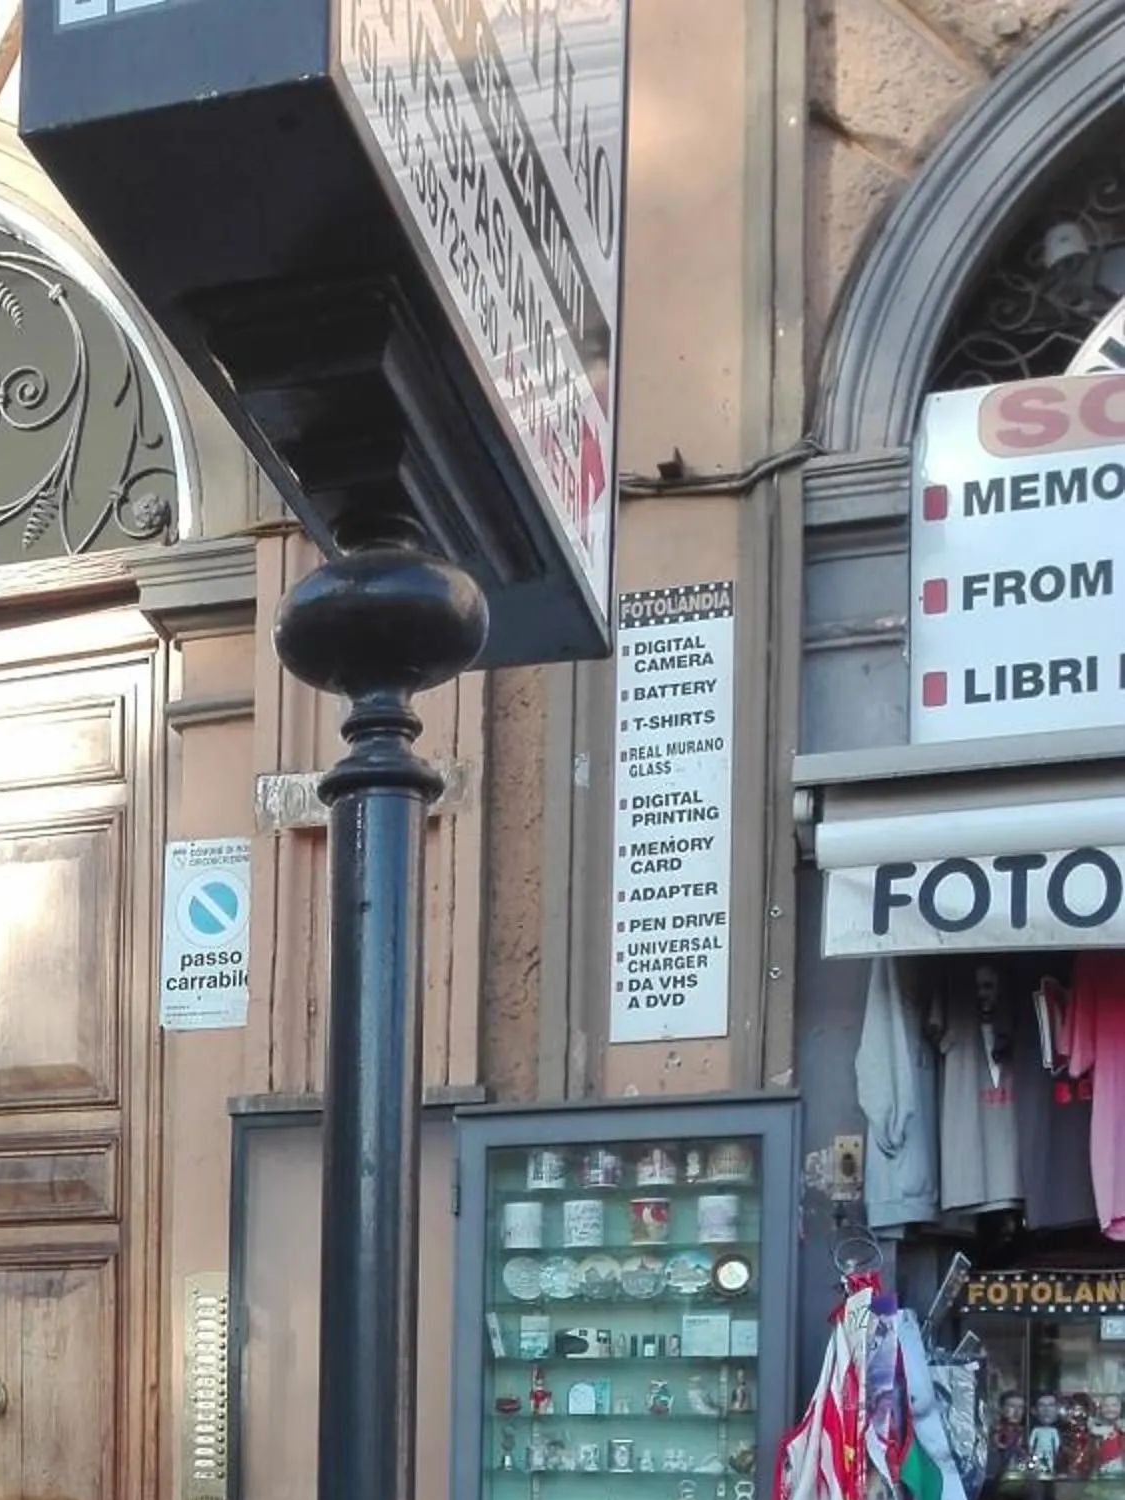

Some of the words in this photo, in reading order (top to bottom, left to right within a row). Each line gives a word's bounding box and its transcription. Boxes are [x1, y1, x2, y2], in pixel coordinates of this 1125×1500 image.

[552, 15, 614, 260] HAO
[475, 20, 536, 228] SENZA
[540, 184, 584, 342] LIMITI
[962, 558, 1114, 611] FROM
[621, 590, 731, 620] FOTOLANDIA
[634, 635, 706, 656] DIGITAL
[634, 652, 714, 673] CAMERA
[634, 678, 717, 701] BATTERY
[964, 655, 1098, 705] LIBRI
[632, 710, 716, 731] T-SHIRTS
[630, 745, 663, 761] REAL
[667, 737, 724, 757] MURANO
[629, 761, 672, 778] GLASS
[632, 790, 703, 810] DIGITAL
[632, 806, 720, 827] PRINTING
[630, 836, 714, 857] MEMORY
[630, 857, 682, 874] CARD
[630, 882, 718, 902] ADAPTER
[872, 847, 1123, 936] FOTO
[630, 917, 666, 933] PEN
[672, 911, 727, 929] DRIVE
[628, 936, 723, 957] UNIVERSAL
[180, 950, 243, 971] passo
[627, 955, 708, 974] CHARGER
[628, 977, 654, 993] DA
[659, 974, 698, 989] VHS
[627, 996, 640, 1010] A
[646, 993, 685, 1009] DVD
[968, 1281, 1125, 1305] FOTOLAN
